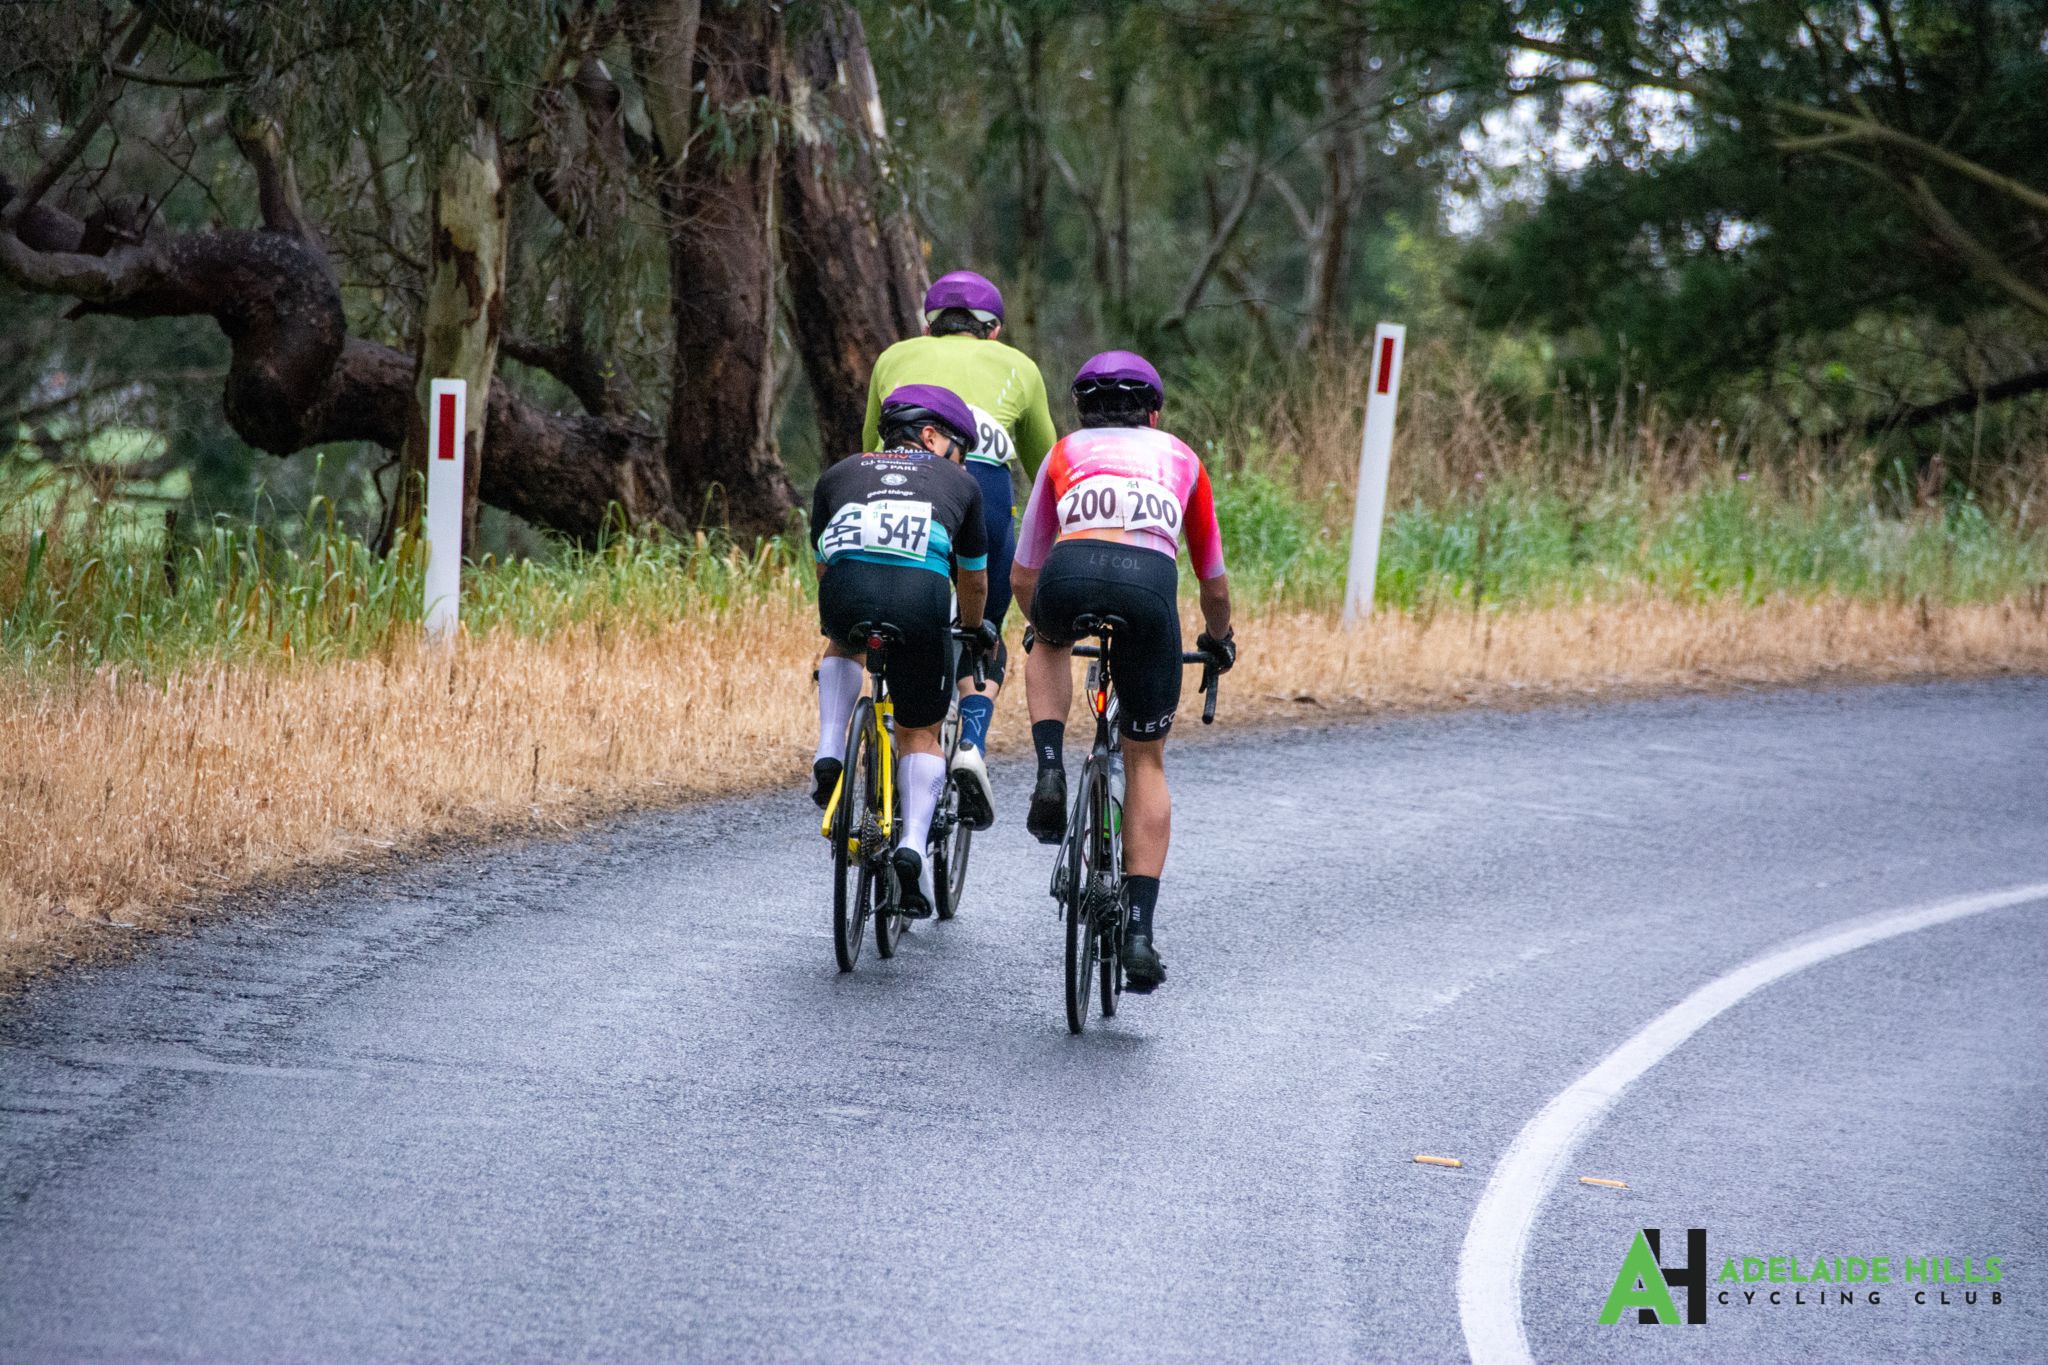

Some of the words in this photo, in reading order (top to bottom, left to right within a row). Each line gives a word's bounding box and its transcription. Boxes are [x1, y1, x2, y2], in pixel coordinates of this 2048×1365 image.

[976, 422, 1008, 460] 90
[1065, 487, 1116, 526] 200
[1127, 491, 1178, 529] 200
[824, 510, 862, 549] 547
[877, 513, 927, 552] 547
[1089, 552, 1109, 566] LE
[1111, 555, 1141, 570] COL
[1132, 720, 1157, 733] LE
